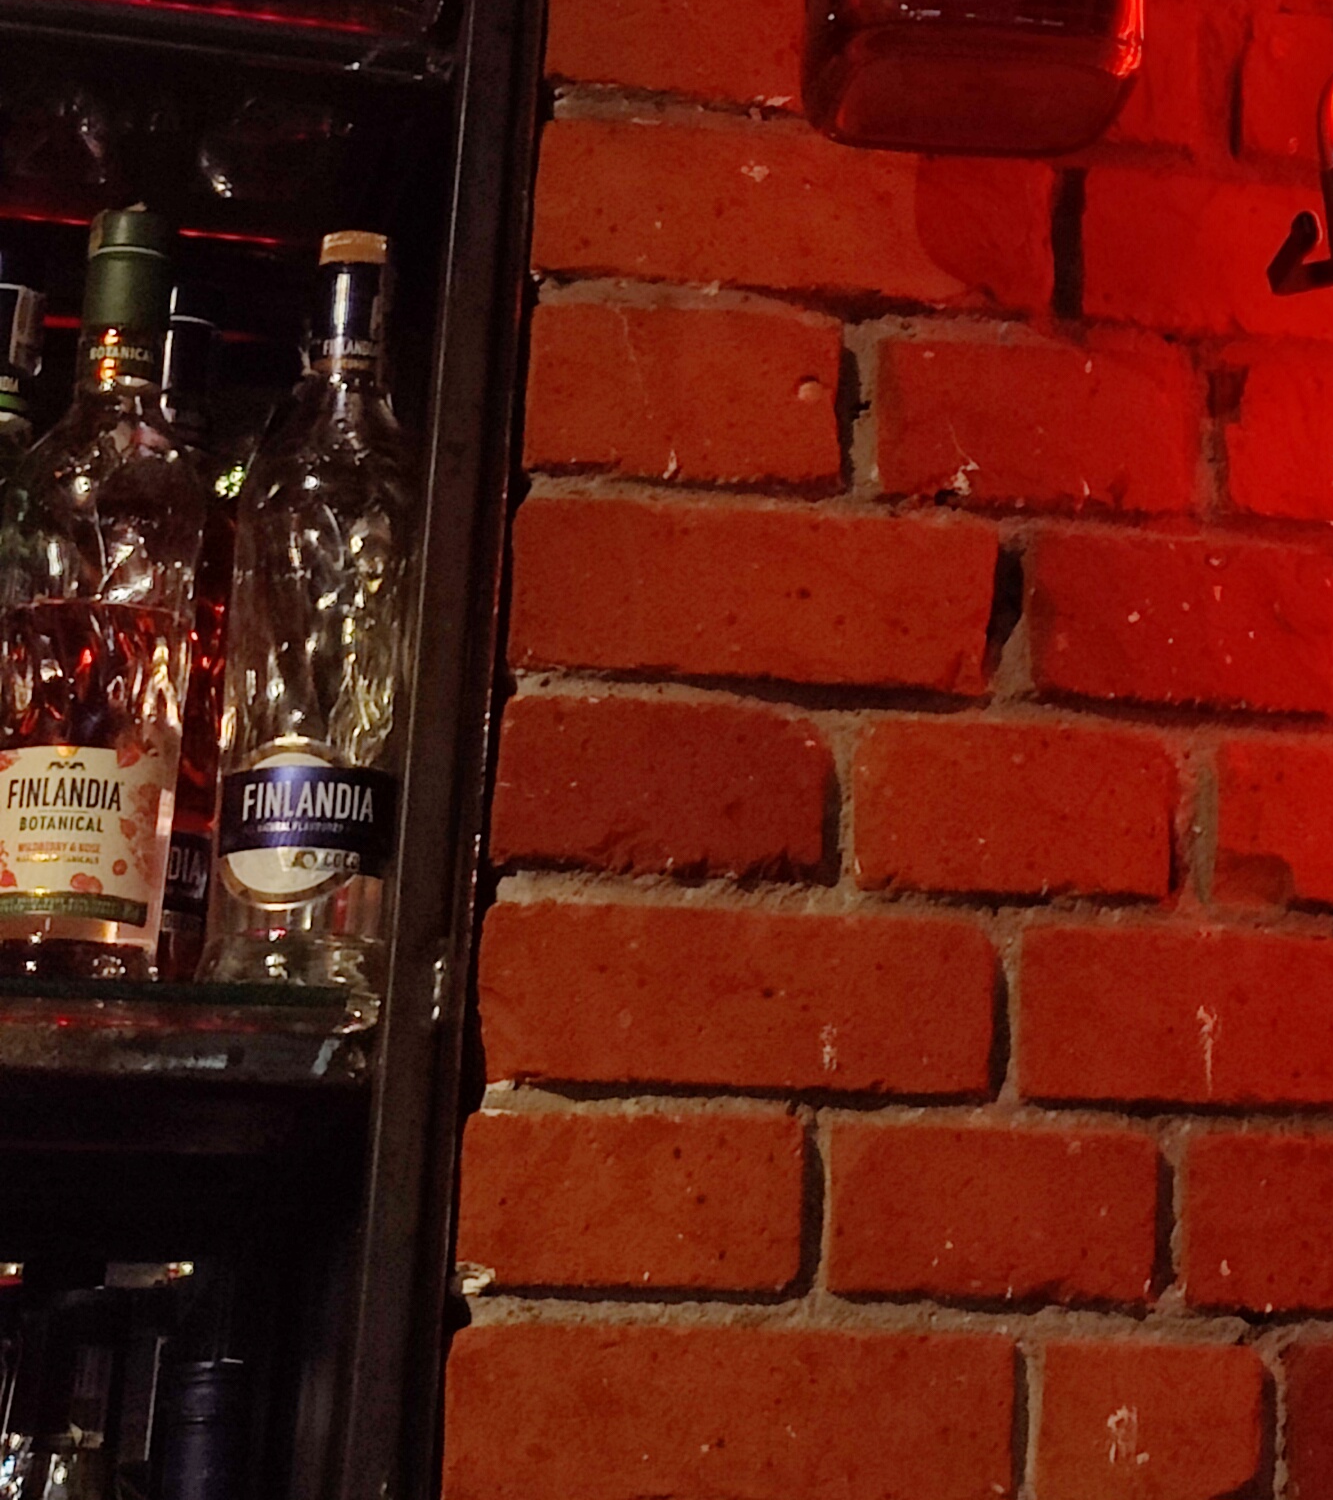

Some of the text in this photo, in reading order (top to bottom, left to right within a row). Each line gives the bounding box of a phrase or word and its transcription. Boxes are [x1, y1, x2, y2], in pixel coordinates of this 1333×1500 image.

[7, 777, 121, 811] FINLANDIA
[242, 780, 374, 822] FINLANDIA
[19, 816, 104, 833] BOTANICAL
